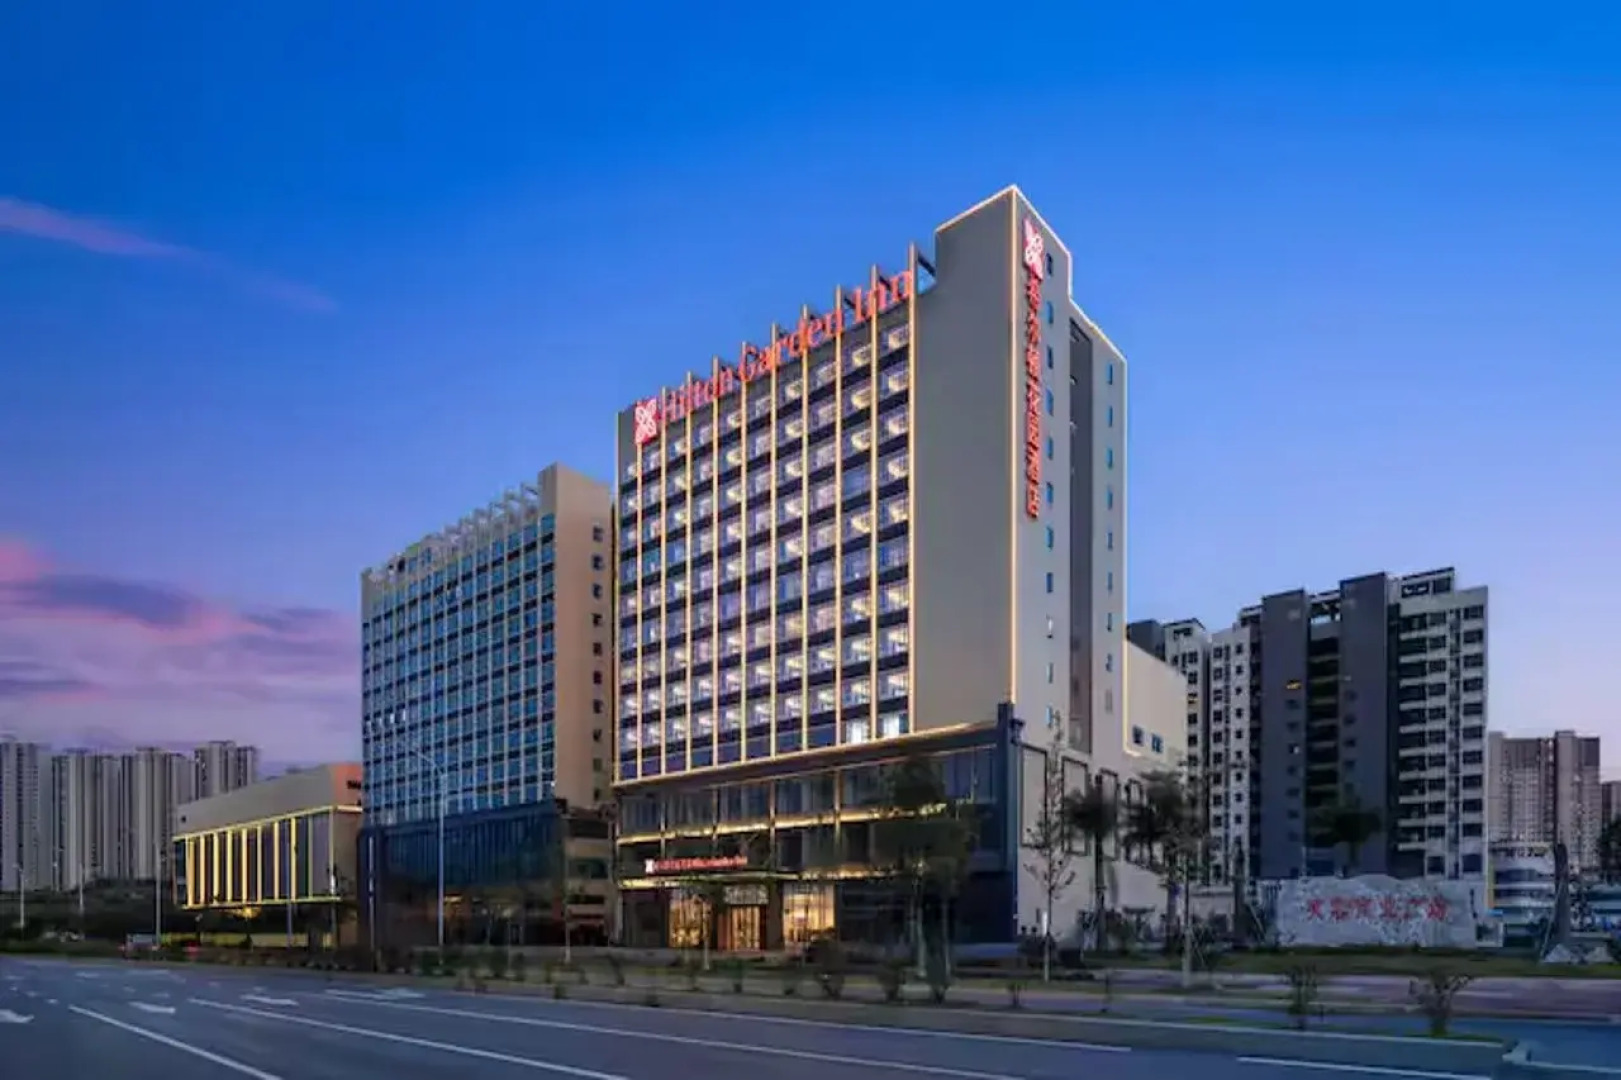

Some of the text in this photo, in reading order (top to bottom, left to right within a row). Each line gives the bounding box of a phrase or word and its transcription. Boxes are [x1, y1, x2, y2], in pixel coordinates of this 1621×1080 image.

[661, 270, 913, 422] Hilton Garden Inn
